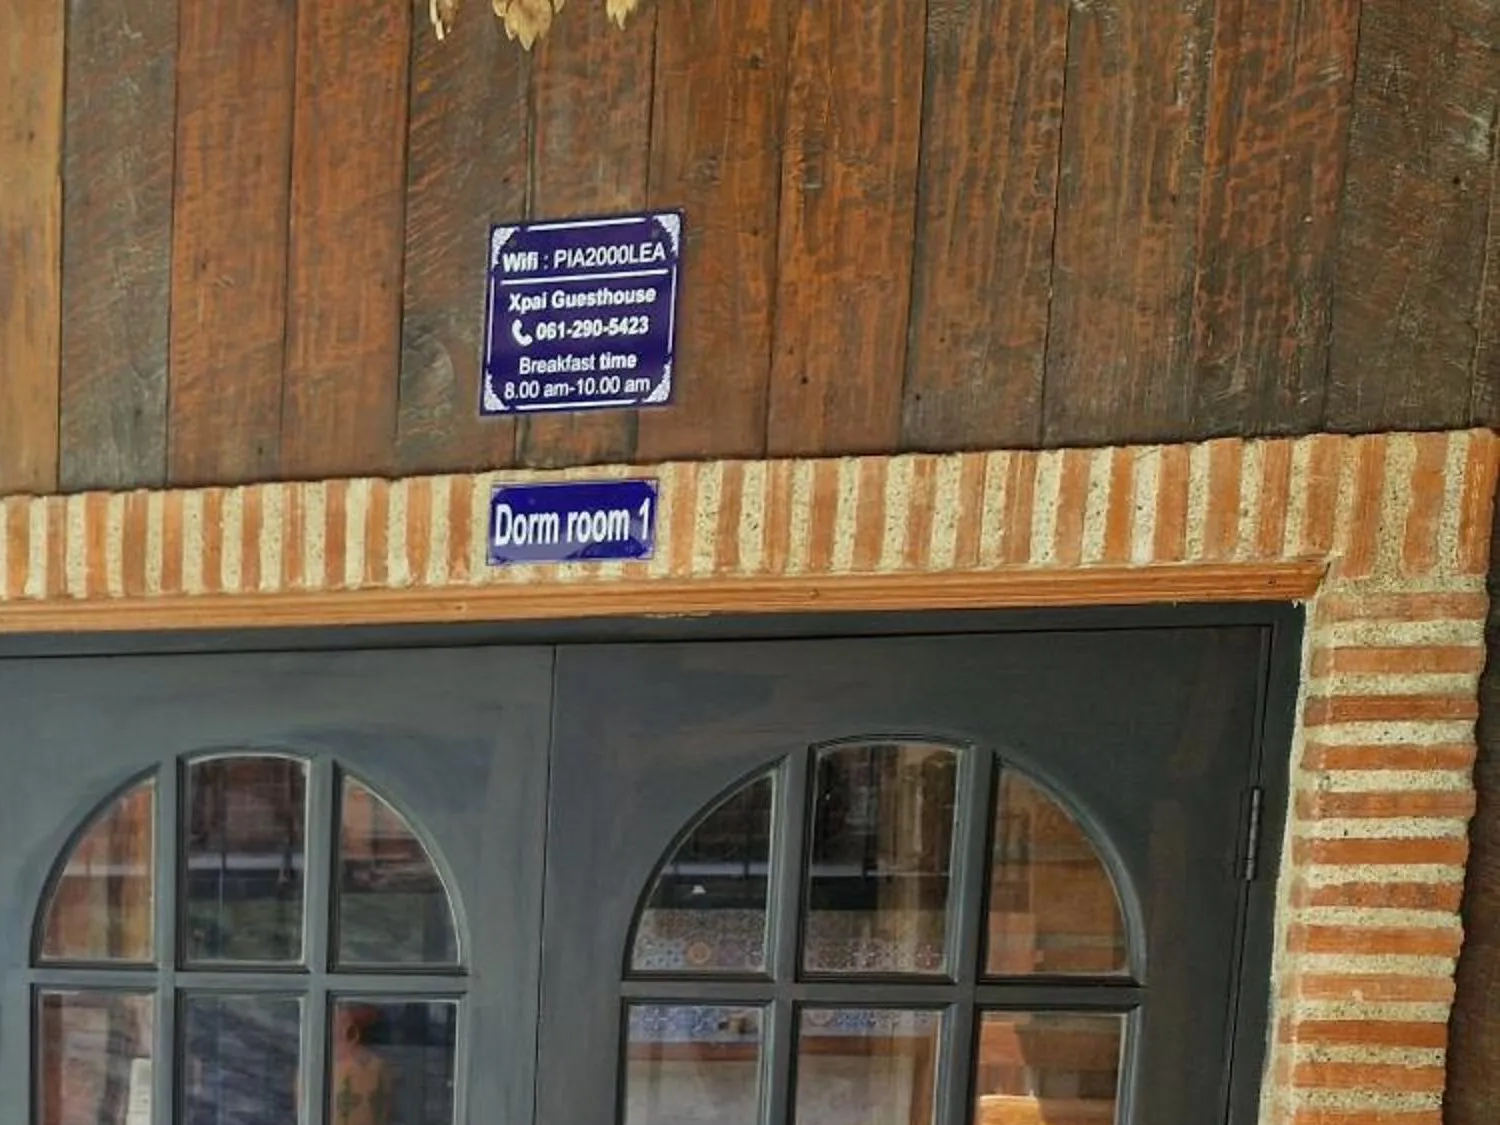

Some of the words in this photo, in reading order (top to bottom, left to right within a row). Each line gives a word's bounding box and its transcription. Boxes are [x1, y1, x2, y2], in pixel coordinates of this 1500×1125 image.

[502, 251, 539, 272] Wifi
[553, 242, 666, 269] PIA2000LEA
[508, 291, 547, 314] Xpai
[551, 287, 657, 310] Guesthouse
[535, 316, 649, 341] 061-290-5423
[519, 354, 596, 375] Breakfast
[600, 352, 637, 370] time
[504, 381, 540, 399] 8.00
[624, 377, 650, 393] am
[494, 503, 560, 546] Dorm
[566, 508, 630, 543] room
[638, 497, 650, 540] 1
